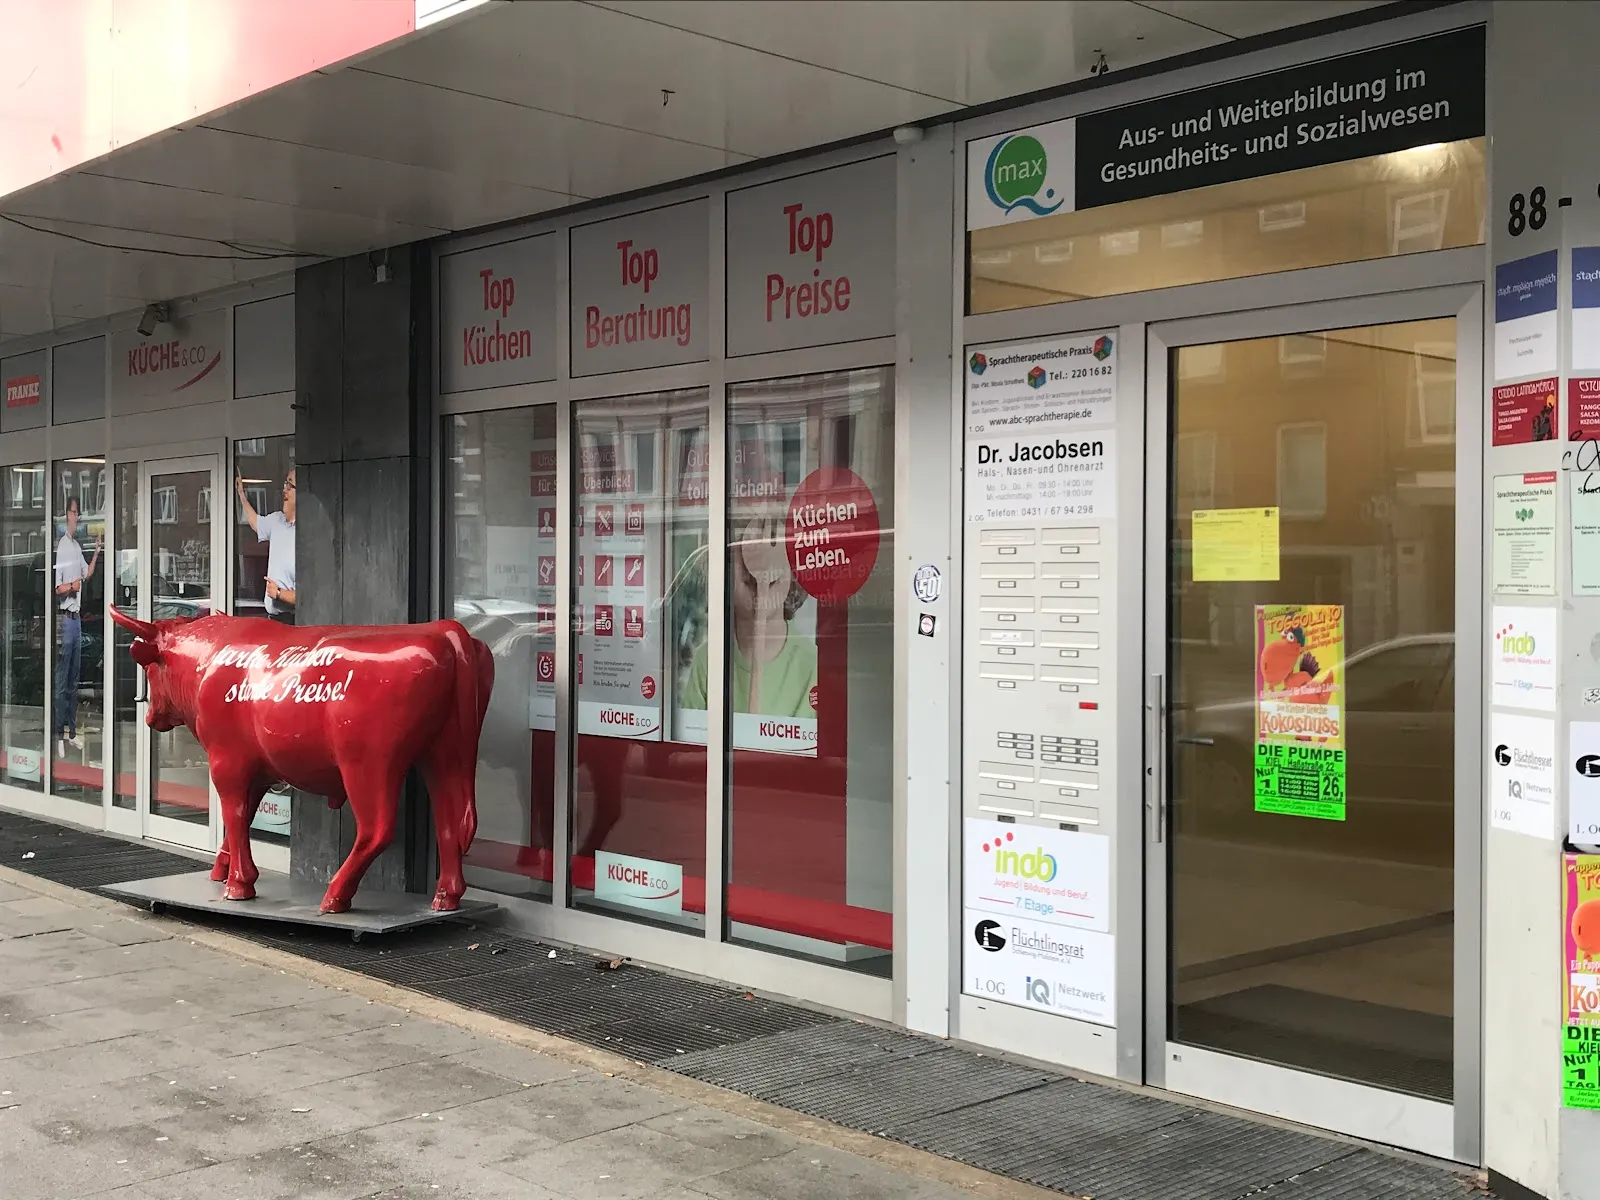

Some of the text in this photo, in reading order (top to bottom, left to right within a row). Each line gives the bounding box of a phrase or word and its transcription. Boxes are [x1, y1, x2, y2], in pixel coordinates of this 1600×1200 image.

[1118, 68, 1426, 150] Aus- und Weiterbildung im
[1100, 100, 1450, 183] Gesundheits- und Sozialwesen
[998, 156, 1043, 184] max
[1508, 186, 1547, 236] 88
[783, 203, 834, 262] Top
[617, 240, 658, 293] Top
[480, 268, 515, 318] Top
[766, 269, 851, 322] Preise
[586, 302, 691, 349] Beratung
[463, 320, 532, 366] Küchen
[128, 341, 180, 376] KÜCHE
[989, 346, 1092, 367] Sprachtherapeutische Praxis
[1049, 365, 1112, 381] Tel.: 220 16 82
[7, 381, 40, 401] FRANKE
[989, 408, 1092, 427] www.abc-sprachtherapie.de
[974, 425, 985, 433] OG
[538, 454, 557, 467] Uns
[687, 449, 709, 467] Guc
[977, 439, 1104, 464] Dr. Jacobsen
[977, 467, 1004, 478] Hals-,
[1057, 461, 1104, 473] Ohrenarzt
[538, 479, 551, 492] für
[583, 472, 631, 490] Überblick!
[687, 477, 778, 500] toll üchen!
[1497, 488, 1553, 498] Sprachtherapeutische Praxis
[792, 502, 858, 529] Küchen
[974, 514, 985, 522] OG
[987, 508, 1019, 518] Telefon:
[1021, 506, 1041, 517] 0431
[1050, 506, 1061, 515] 67
[1063, 505, 1075, 515] 94
[1077, 504, 1094, 514] 298
[794, 526, 830, 549] zum
[795, 547, 851, 571] Leben.
[273, 670, 354, 703] Preise!
[600, 708, 635, 725] KÜCHE
[1260, 711, 1339, 736] Kokosnuss
[759, 720, 801, 740] KÜCHE
[1258, 744, 1344, 763] DIE PUMPE
[1255, 766, 1275, 778] Nur
[1265, 757, 1281, 767] KIEL
[1325, 762, 1335, 772] 22
[995, 846, 1058, 883] inab
[607, 863, 649, 887] KÜCHE
[993, 877, 1019, 890] Jugend
[1023, 882, 1051, 896] Bildung
[1052, 887, 1066, 897] und
[1014, 896, 1054, 916] 7. Etage
[1011, 927, 1085, 958] Flüchtlingsrat
[985, 979, 1007, 996] OG
[1025, 976, 1107, 1006] iQ Netzwerk
[1567, 1026, 1600, 1042] DIE
[1563, 1053, 1593, 1067] Nur
[1570, 1068, 1586, 1080] 1
[1566, 1080, 1596, 1089] TAG
